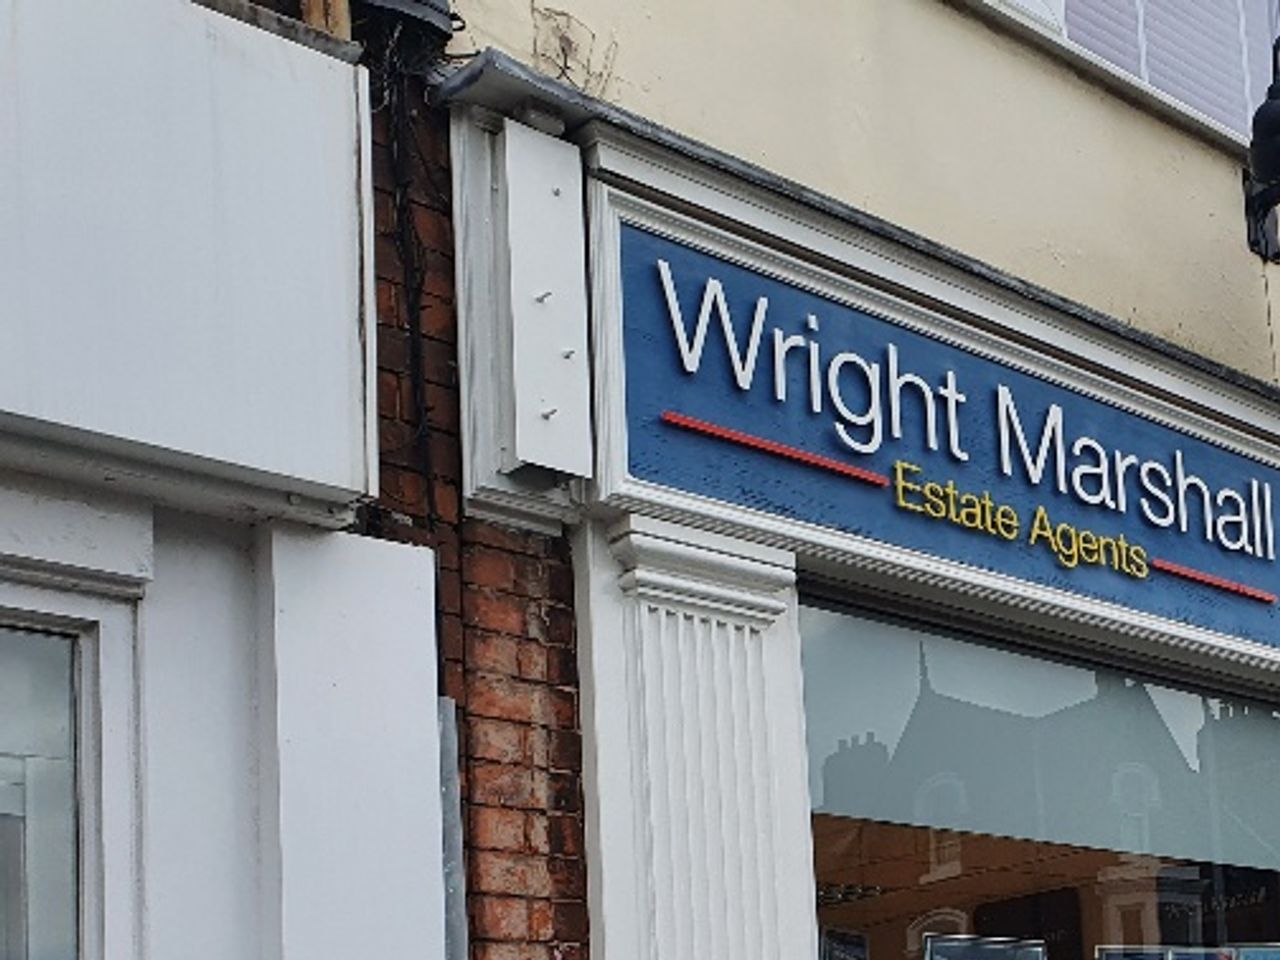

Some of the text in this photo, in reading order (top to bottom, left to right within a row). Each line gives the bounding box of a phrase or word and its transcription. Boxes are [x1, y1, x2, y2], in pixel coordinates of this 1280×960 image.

[658, 258, 1276, 561] Wright Marshall
[894, 460, 1150, 579] Estate Agents
